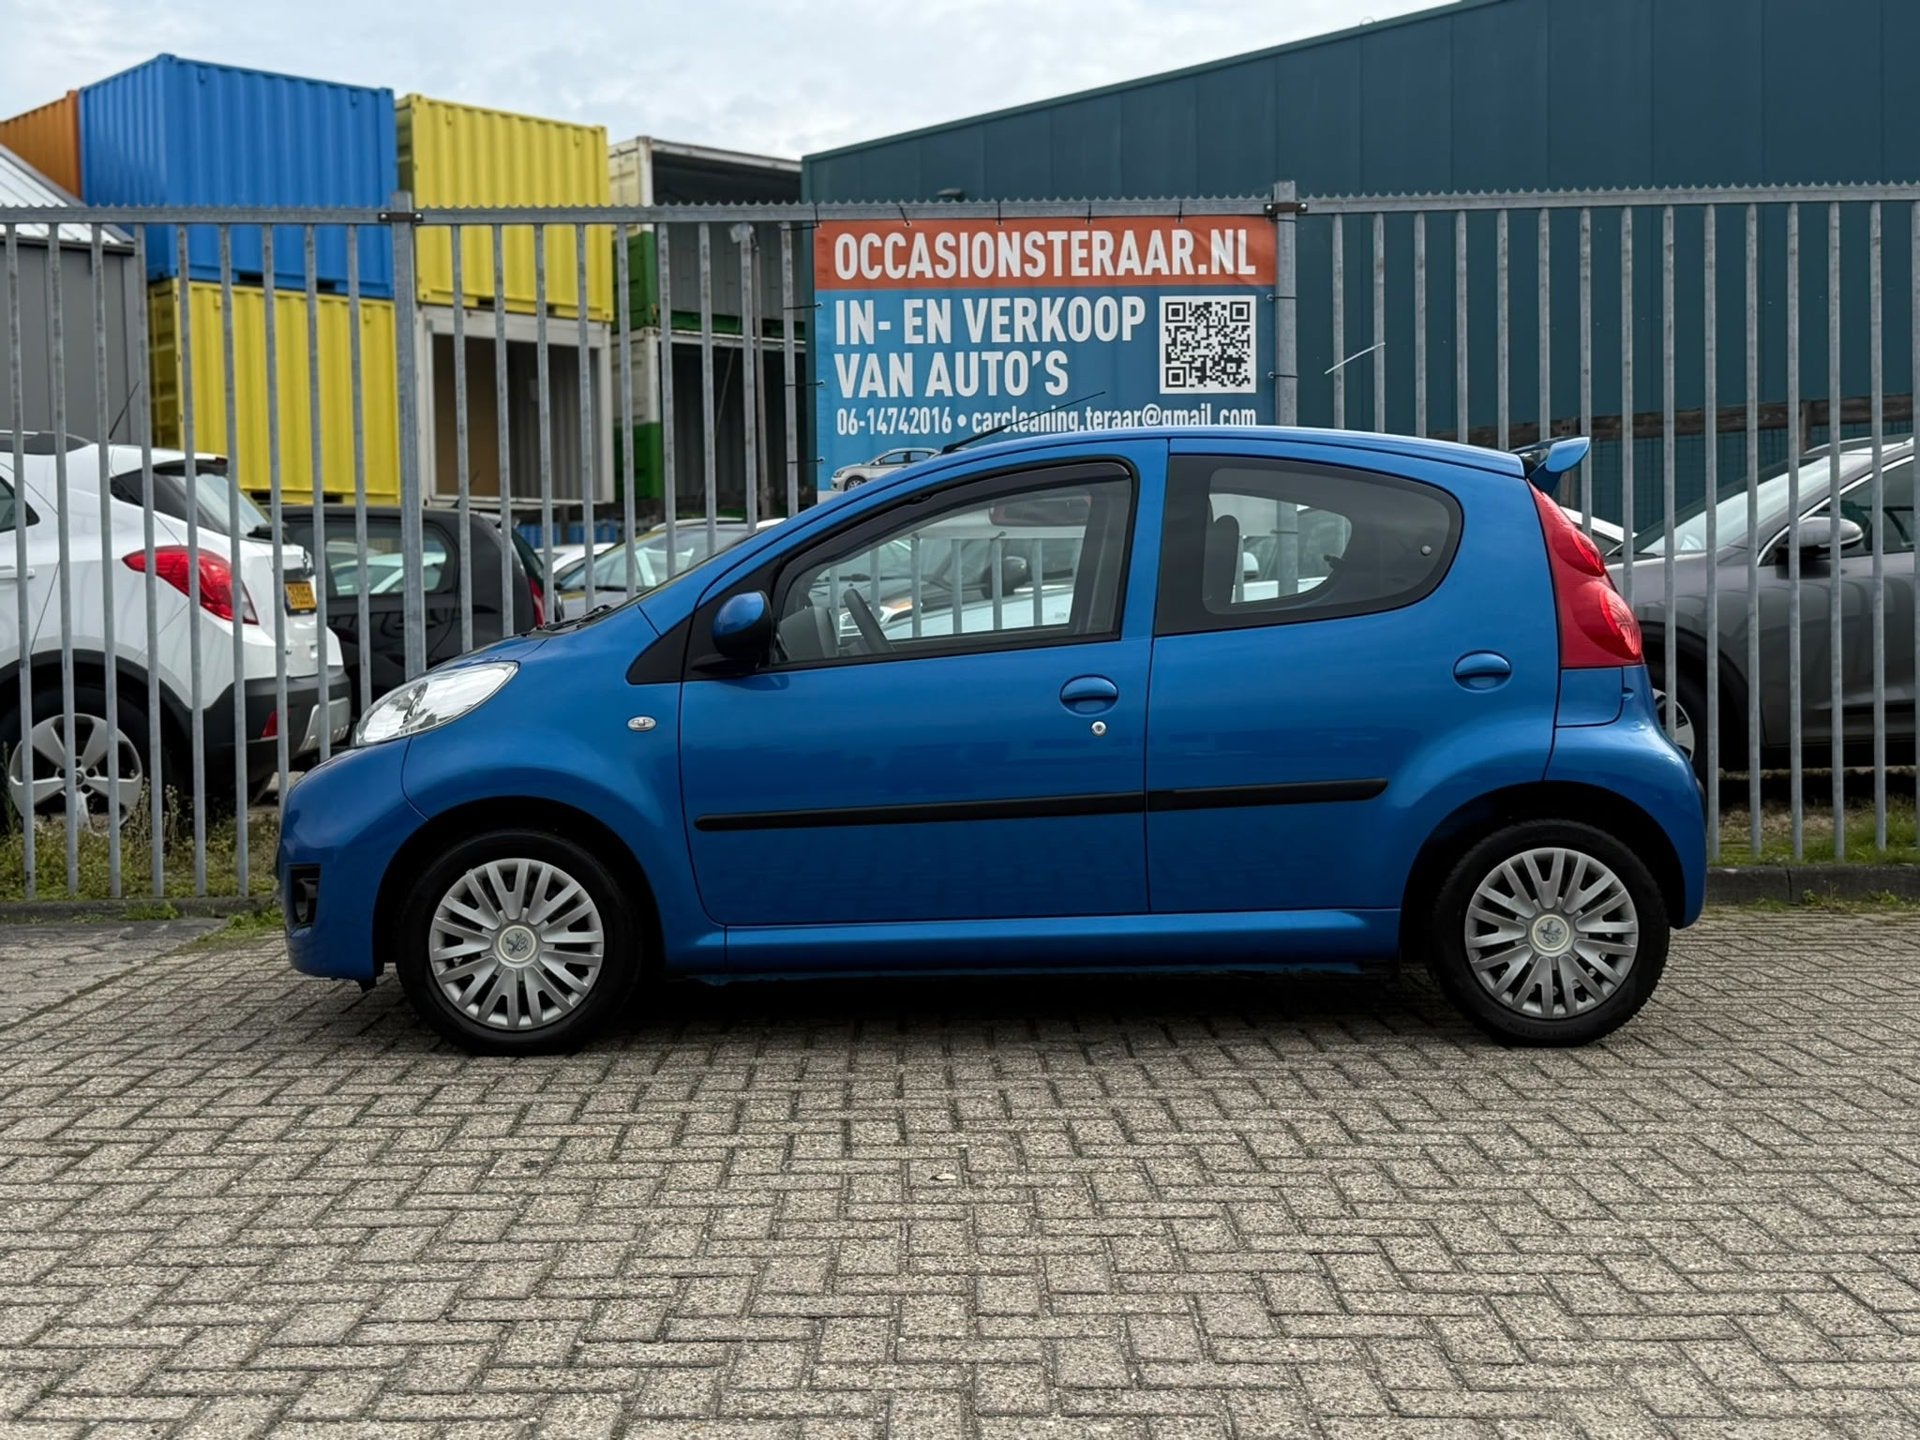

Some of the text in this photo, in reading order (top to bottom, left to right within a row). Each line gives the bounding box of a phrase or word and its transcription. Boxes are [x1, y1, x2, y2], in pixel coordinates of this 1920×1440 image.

[834, 228, 1257, 280] OCCASIONSTERAAR.NL
[835, 295, 1146, 345] IN- EN VERKOOP
[834, 349, 1069, 398] VAN AUTO'S
[836, 402, 1257, 436] 06-14742016 carcleaning.teraar@gmailcom
